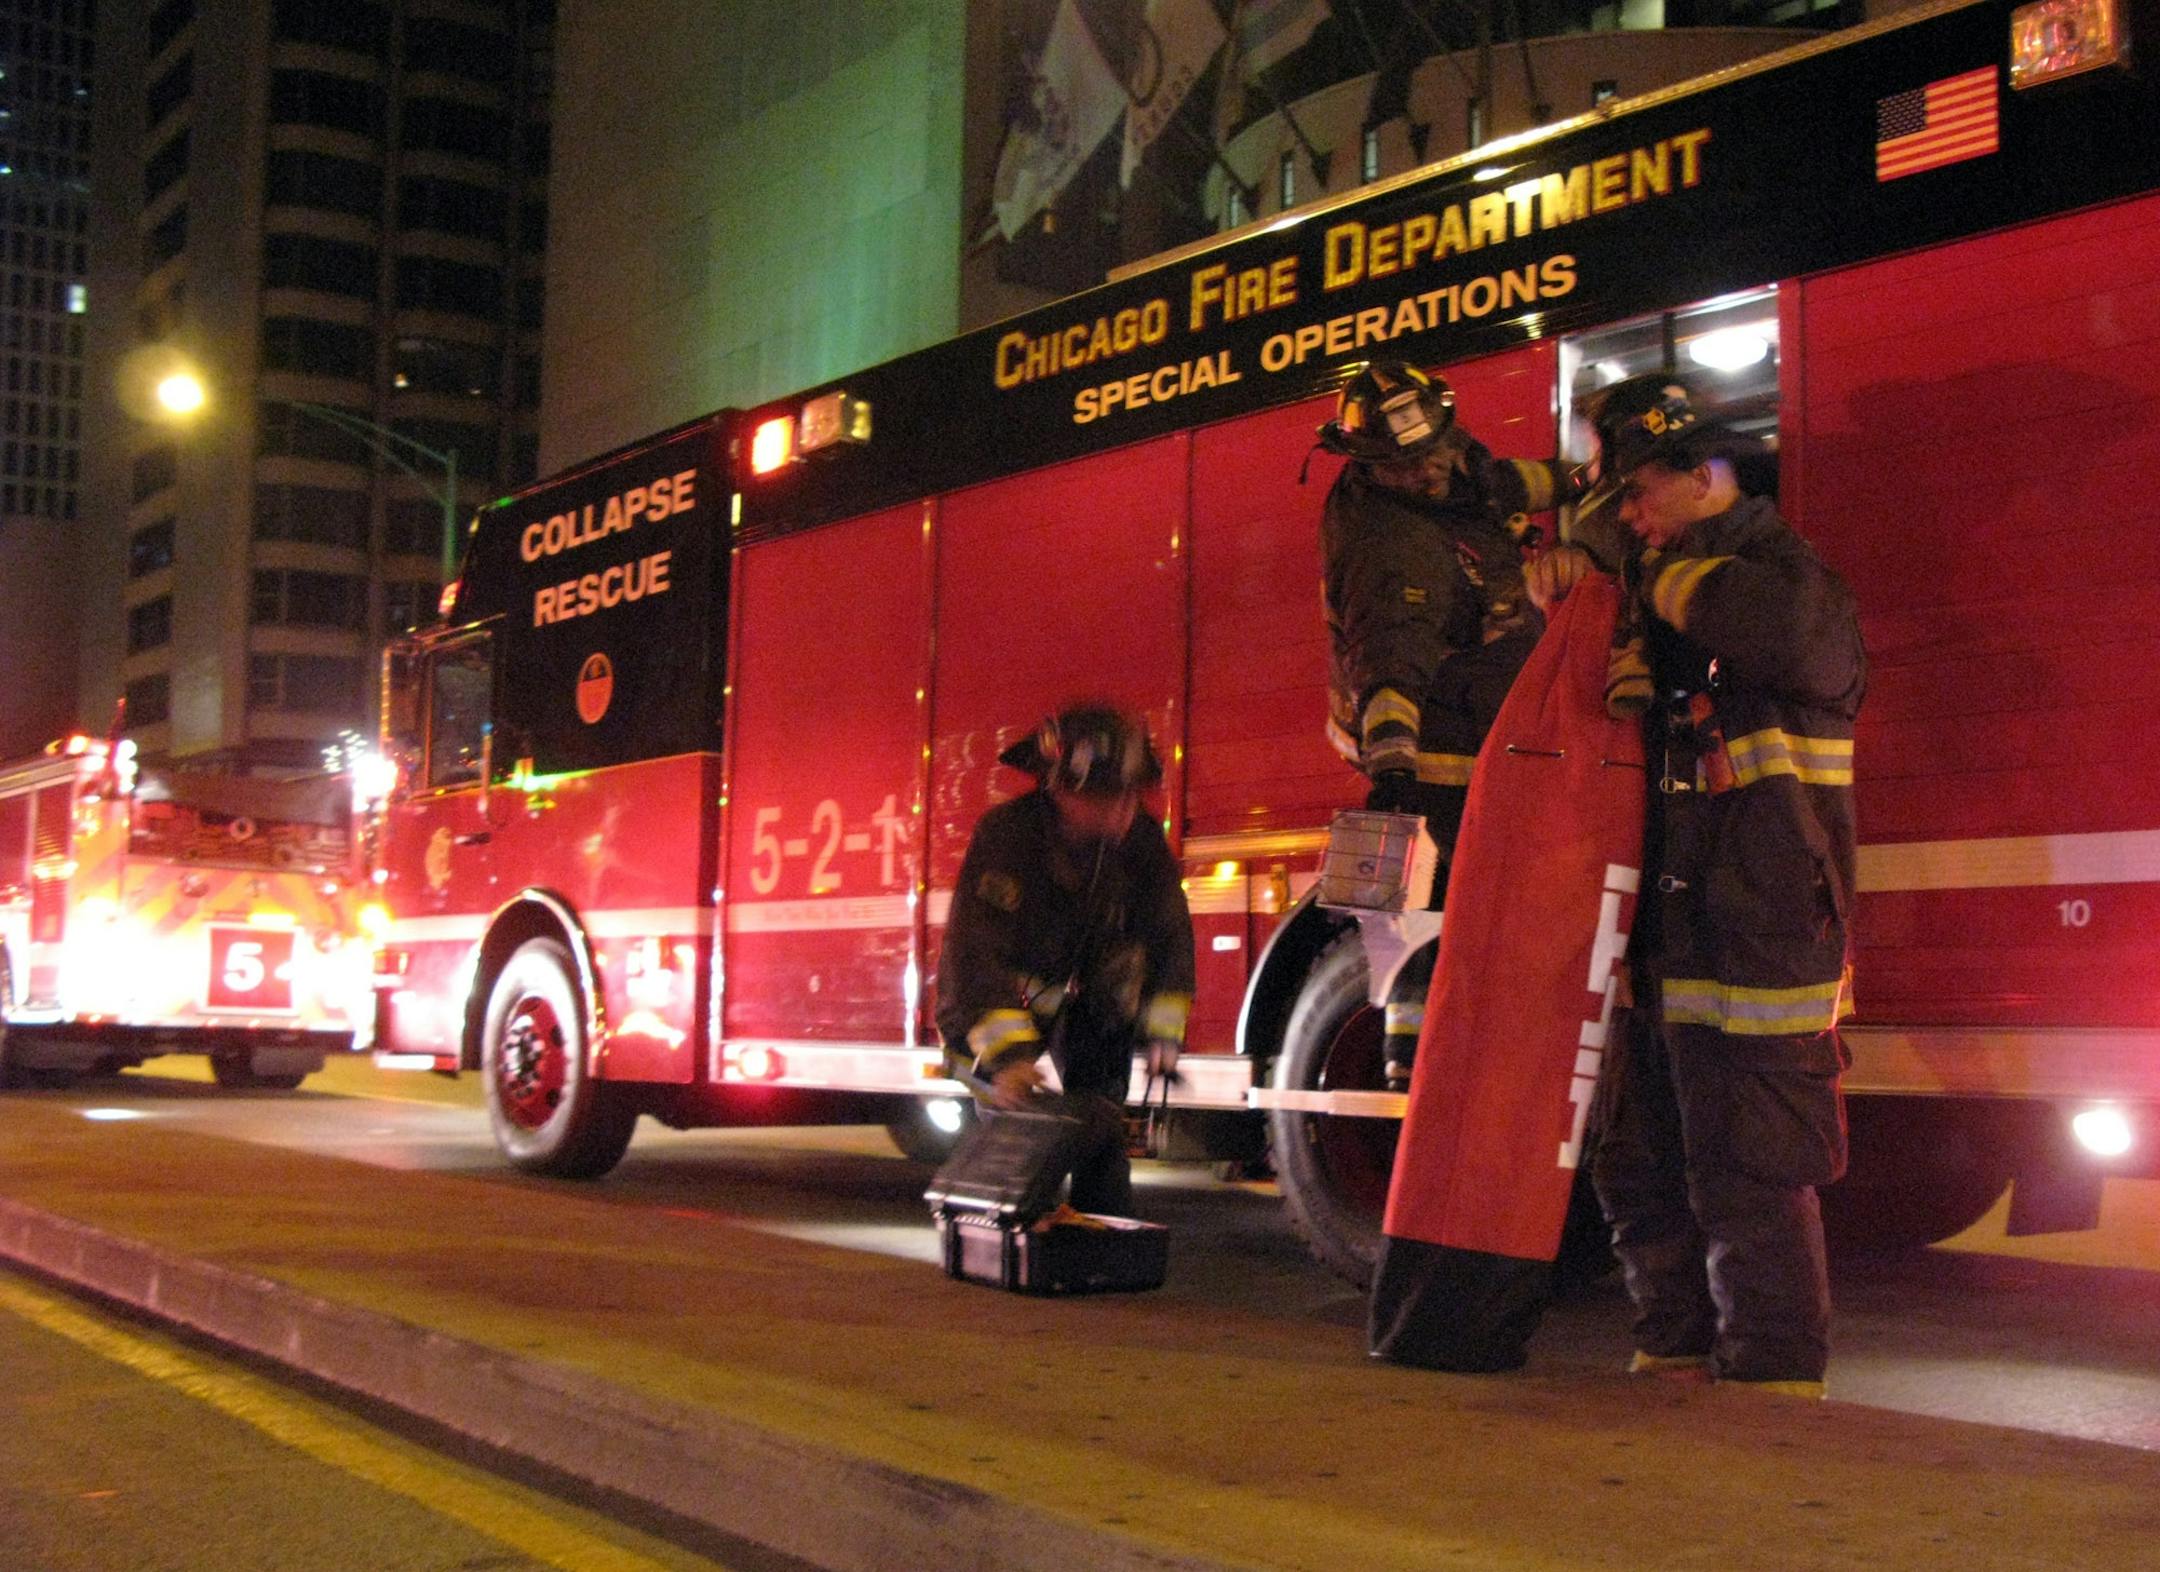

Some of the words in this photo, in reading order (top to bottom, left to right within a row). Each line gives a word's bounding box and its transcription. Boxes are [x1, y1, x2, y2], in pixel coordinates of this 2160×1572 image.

[995, 298, 1169, 392] CHICAGO
[1190, 255, 1299, 333] FIRE
[1323, 128, 1713, 293] DEPARTMENT
[1073, 354, 1242, 426] SPECIAL
[1260, 254, 1579, 374] OPERATIONS
[520, 467, 698, 564] COLLAPSE
[533, 550, 673, 628] RESCUE
[751, 794, 898, 895] 5-2-1
[2056, 899, 2091, 928] 10
